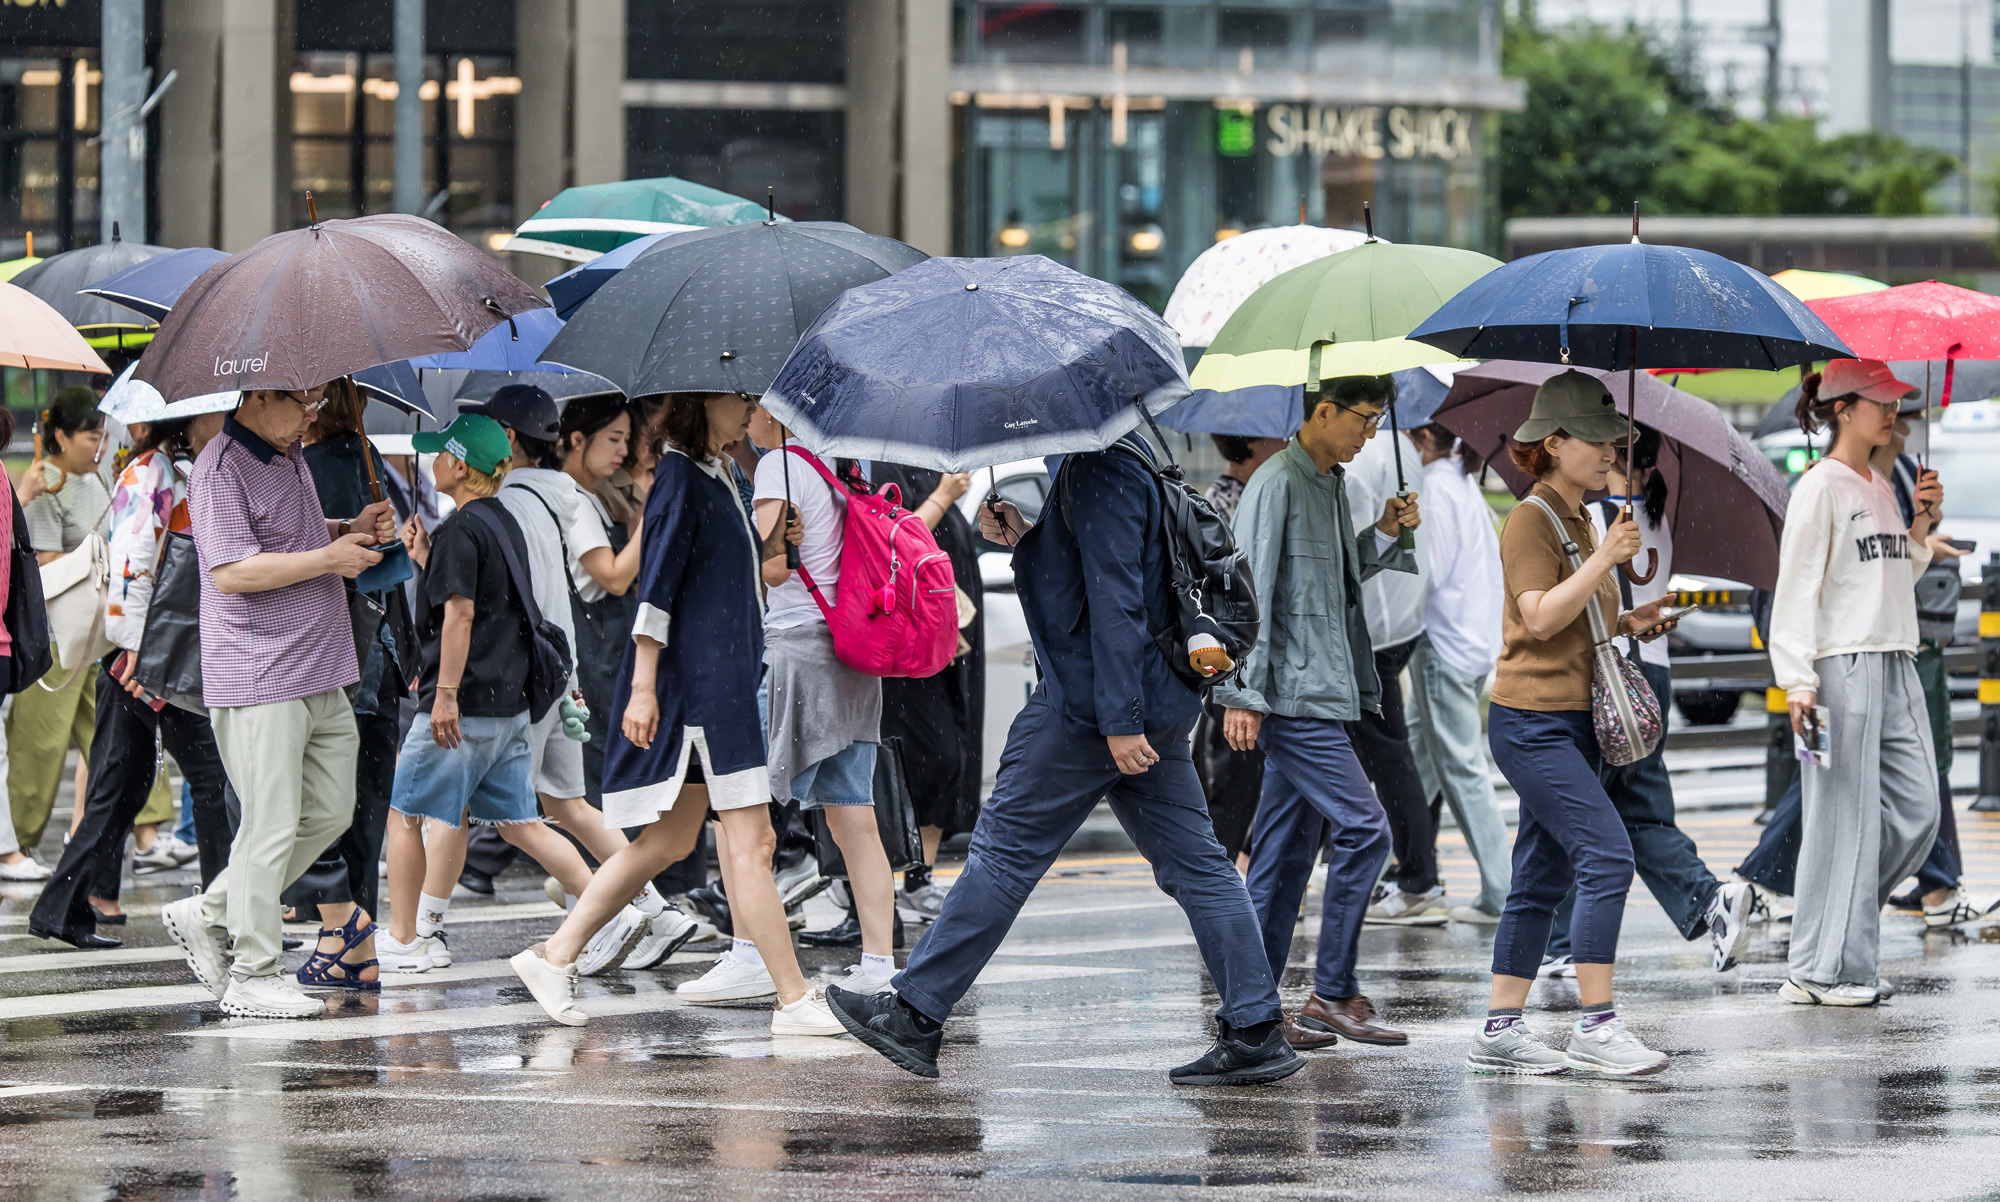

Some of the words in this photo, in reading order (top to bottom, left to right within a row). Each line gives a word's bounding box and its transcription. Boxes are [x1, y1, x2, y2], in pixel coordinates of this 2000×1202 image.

[1266, 104, 1385, 159] SHAKE
[1388, 107, 1473, 160] SHACK
[213, 351, 269, 376] Laurel
[864, 955, 887, 963] FACE
